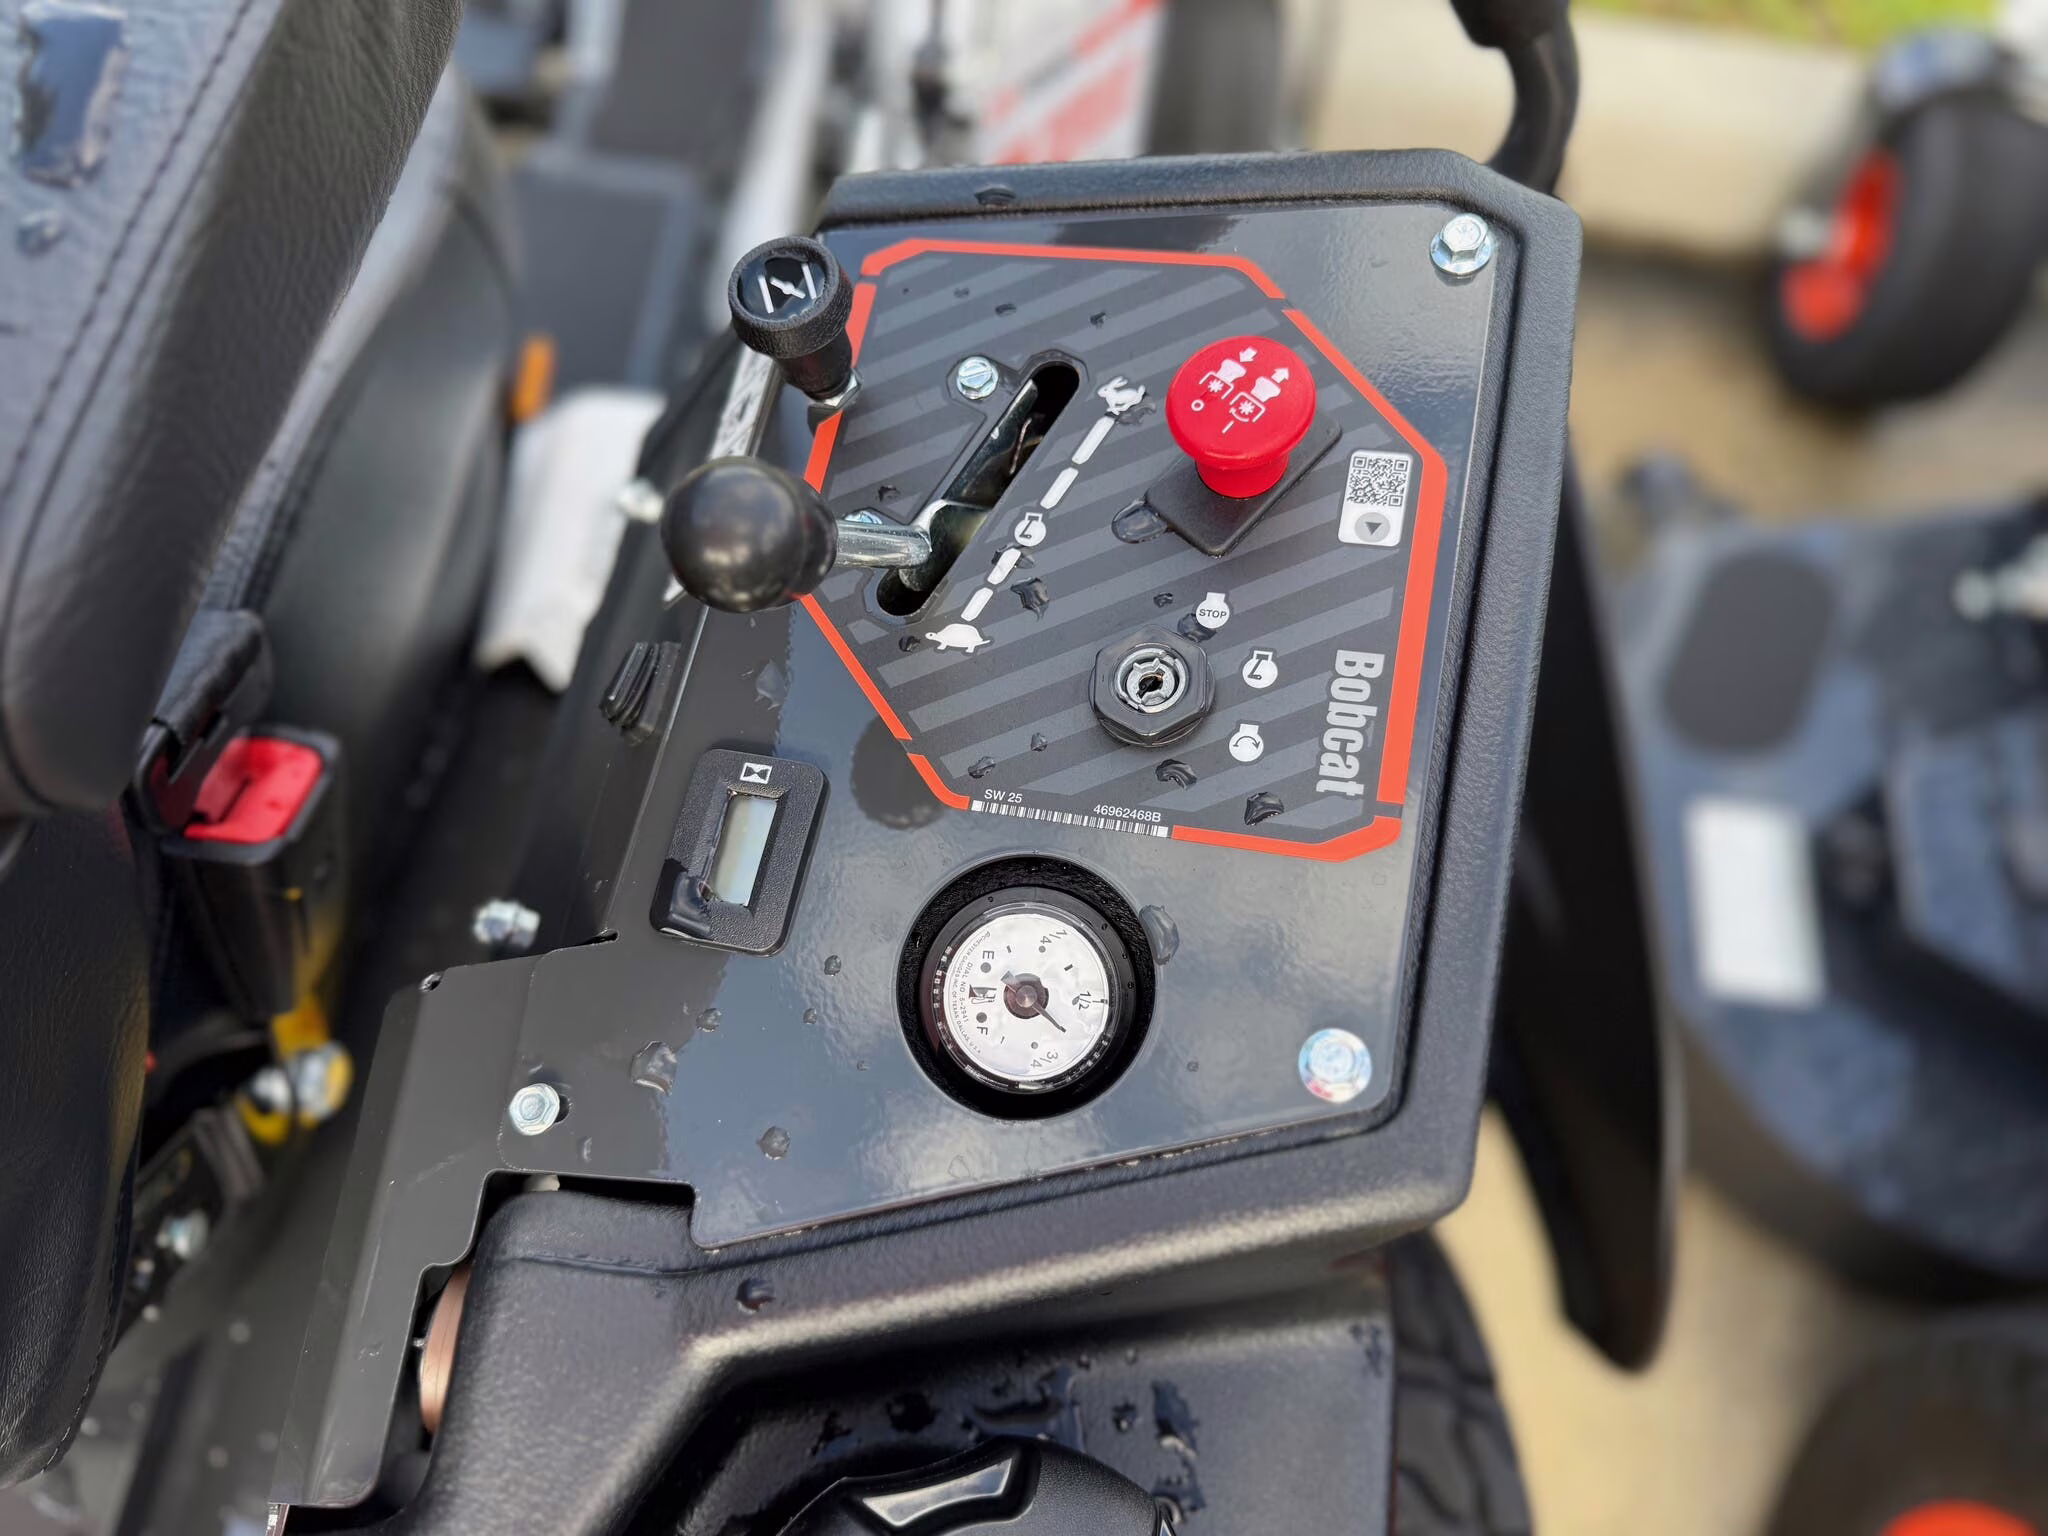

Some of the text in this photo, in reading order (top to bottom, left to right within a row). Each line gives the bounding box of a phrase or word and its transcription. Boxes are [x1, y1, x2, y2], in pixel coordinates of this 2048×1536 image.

[1199, 608, 1227, 619] STOP
[1315, 649, 1385, 797] Bobcat
[984, 789, 1023, 804] SW 25
[1093, 803, 1161, 823] 46962468B
[1040, 929, 1068, 944] 1/4
[982, 950, 994, 960] E
[962, 962, 974, 978] DIAL
[1079, 990, 1092, 1011] 1/2
[976, 1026, 988, 1035] F
[1030, 1051, 1059, 1068] 3/4
